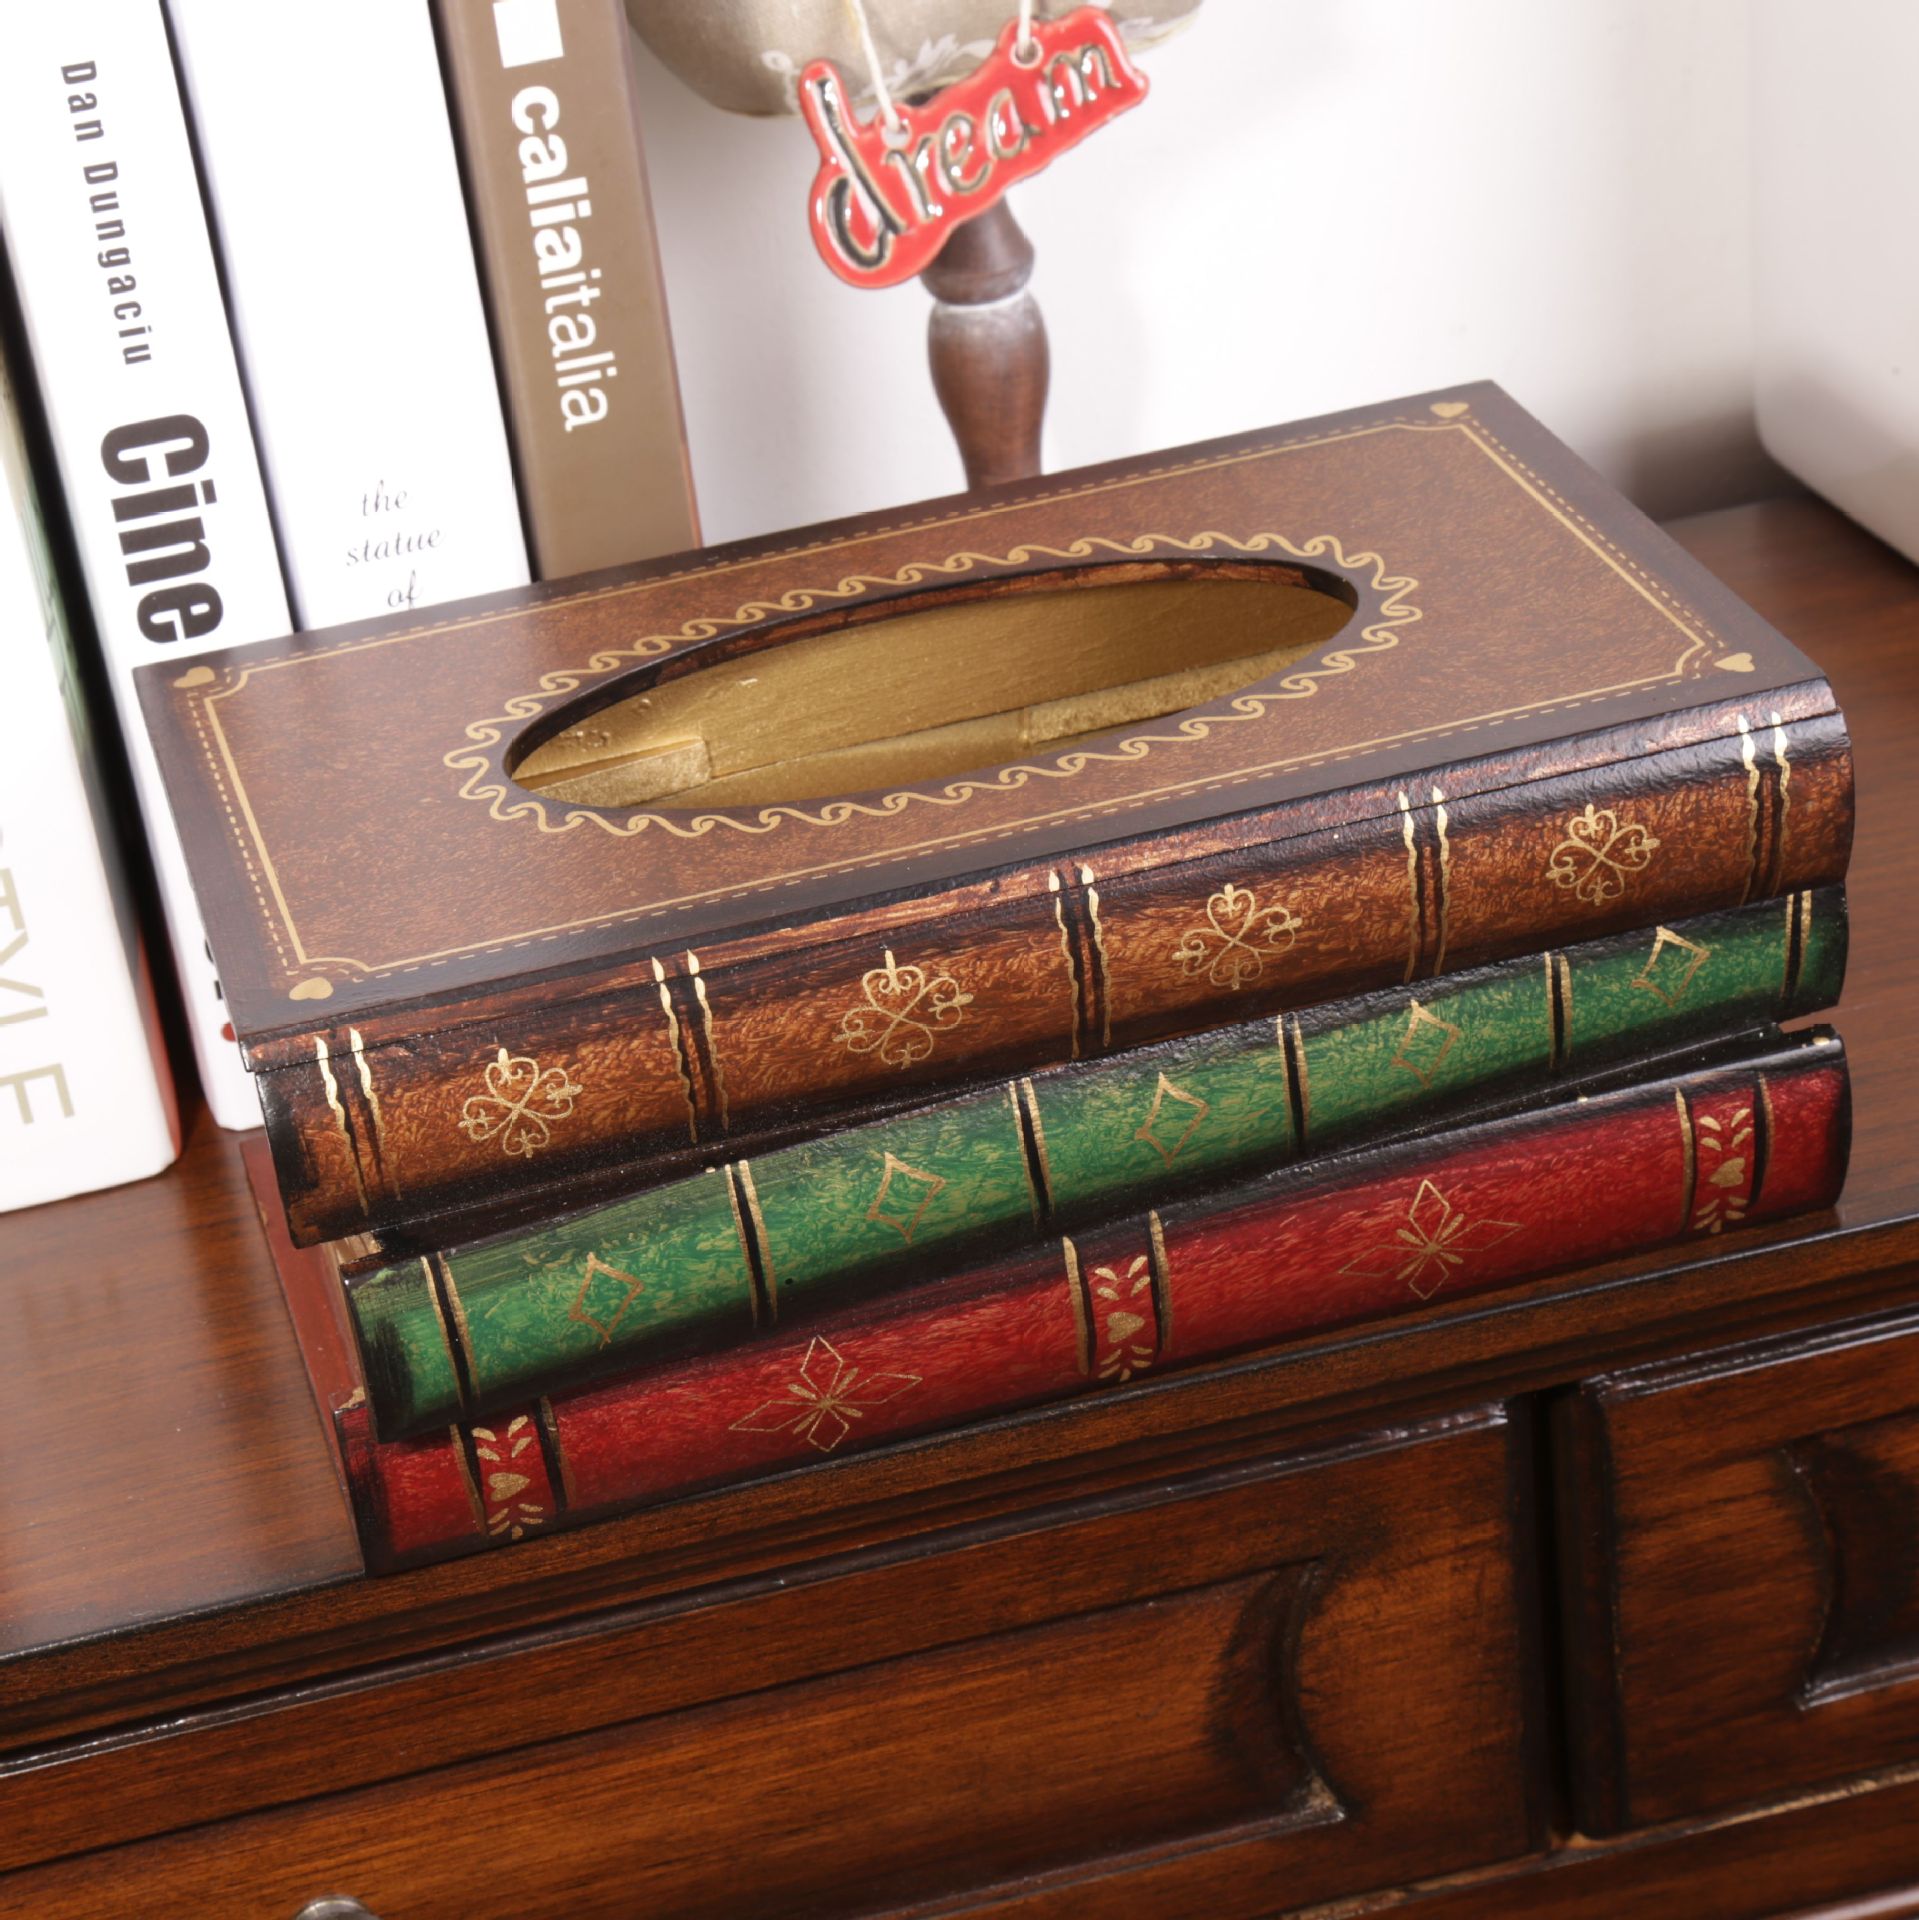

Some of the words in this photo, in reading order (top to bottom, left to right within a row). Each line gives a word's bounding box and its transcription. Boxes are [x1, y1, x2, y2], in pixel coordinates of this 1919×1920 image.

[61, 61, 104, 141] Dan
[84, 162, 151, 364] Dungaciu
[511, 85, 617, 432] caliaitalia
[813, 43, 1121, 268] dream
[101, 414, 224, 644] Cine
[346, 529, 441, 567] statue
[362, 479, 408, 517] the
[387, 569, 423, 608] of
